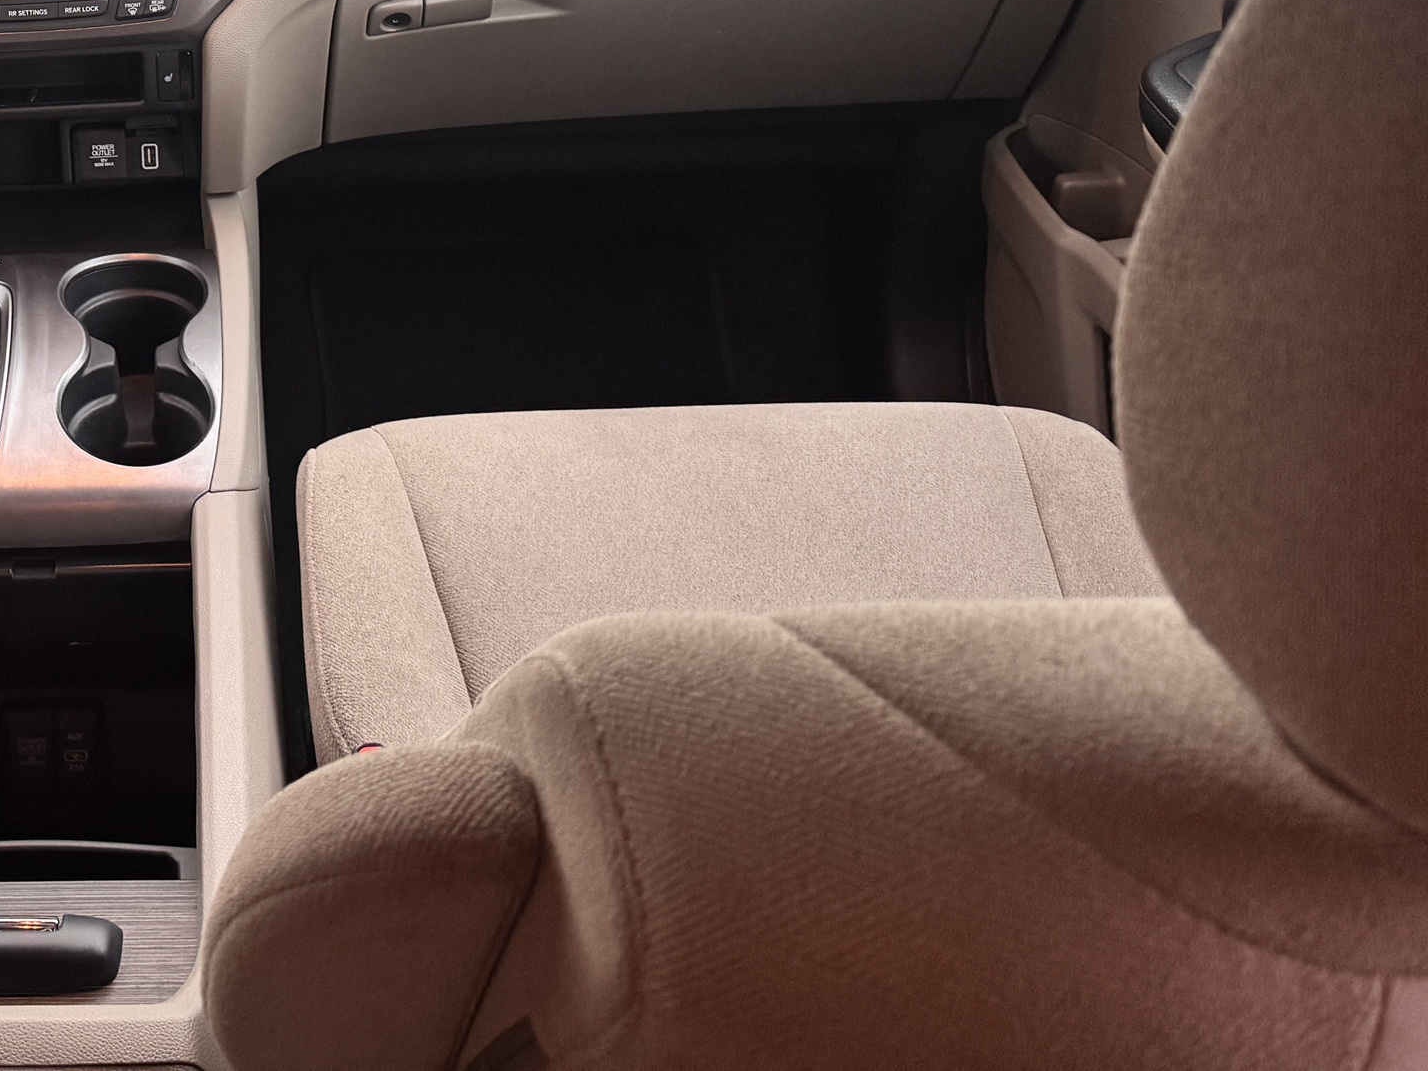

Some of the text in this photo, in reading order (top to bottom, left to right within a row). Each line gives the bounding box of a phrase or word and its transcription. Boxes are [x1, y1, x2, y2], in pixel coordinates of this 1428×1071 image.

[64, 5, 99, 14] REAR LOCK
[16, 744, 47, 752] OUTLET
